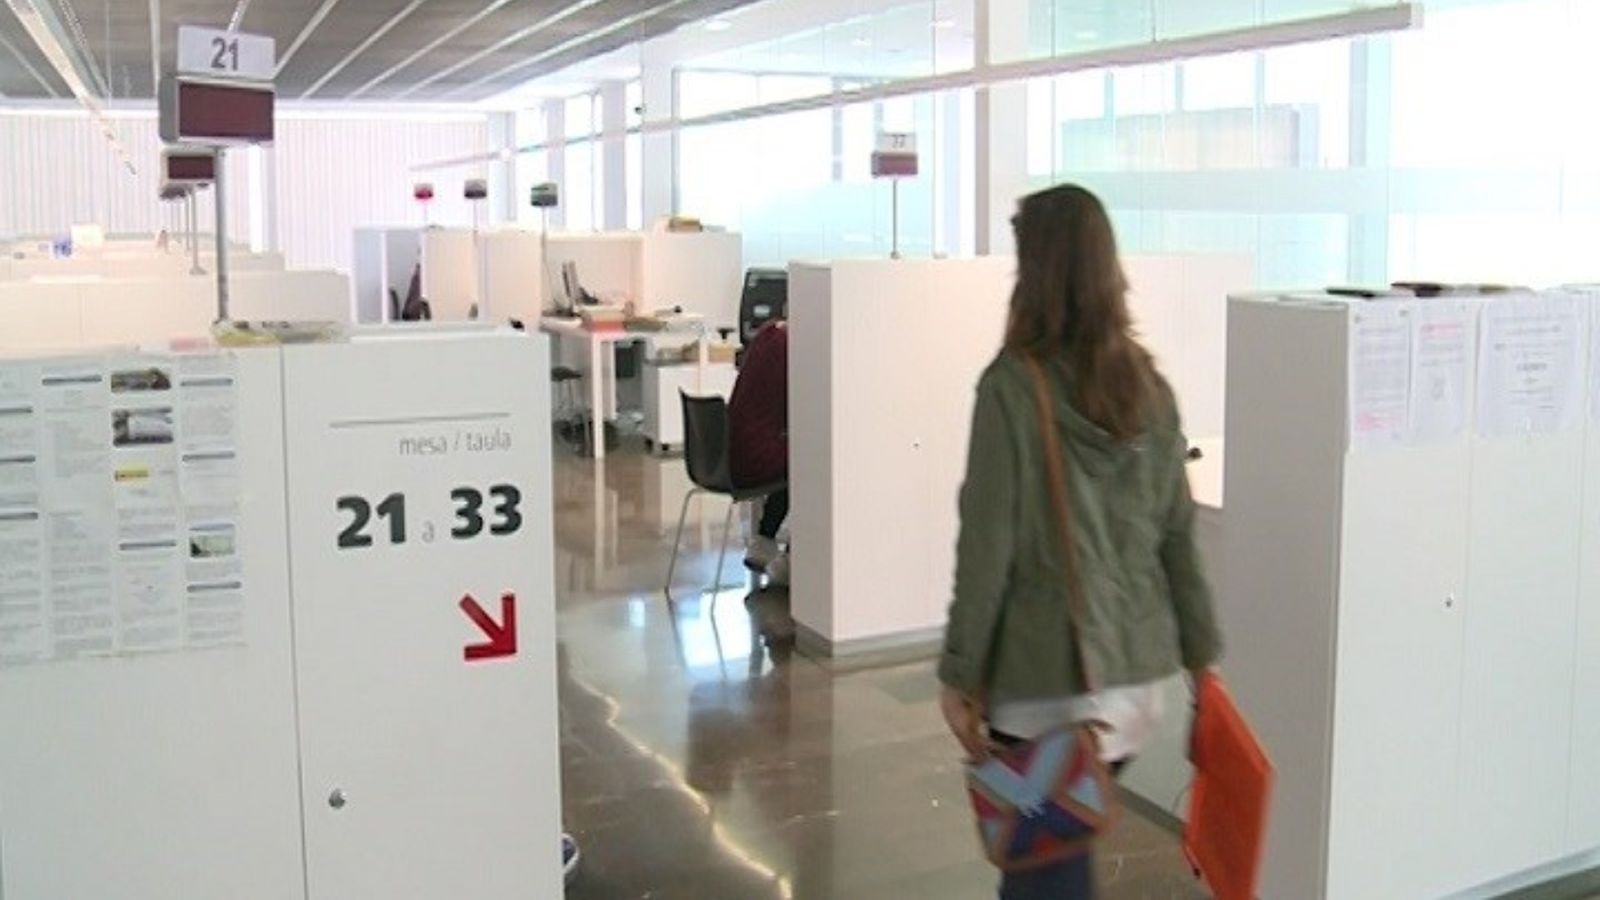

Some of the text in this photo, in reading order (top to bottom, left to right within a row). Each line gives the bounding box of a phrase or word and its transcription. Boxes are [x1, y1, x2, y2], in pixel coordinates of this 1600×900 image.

[211, 37, 239, 71] 21
[399, 435, 448, 456] mesa
[466, 429, 512, 453] taula
[337, 484, 521, 548] 21 a 33
